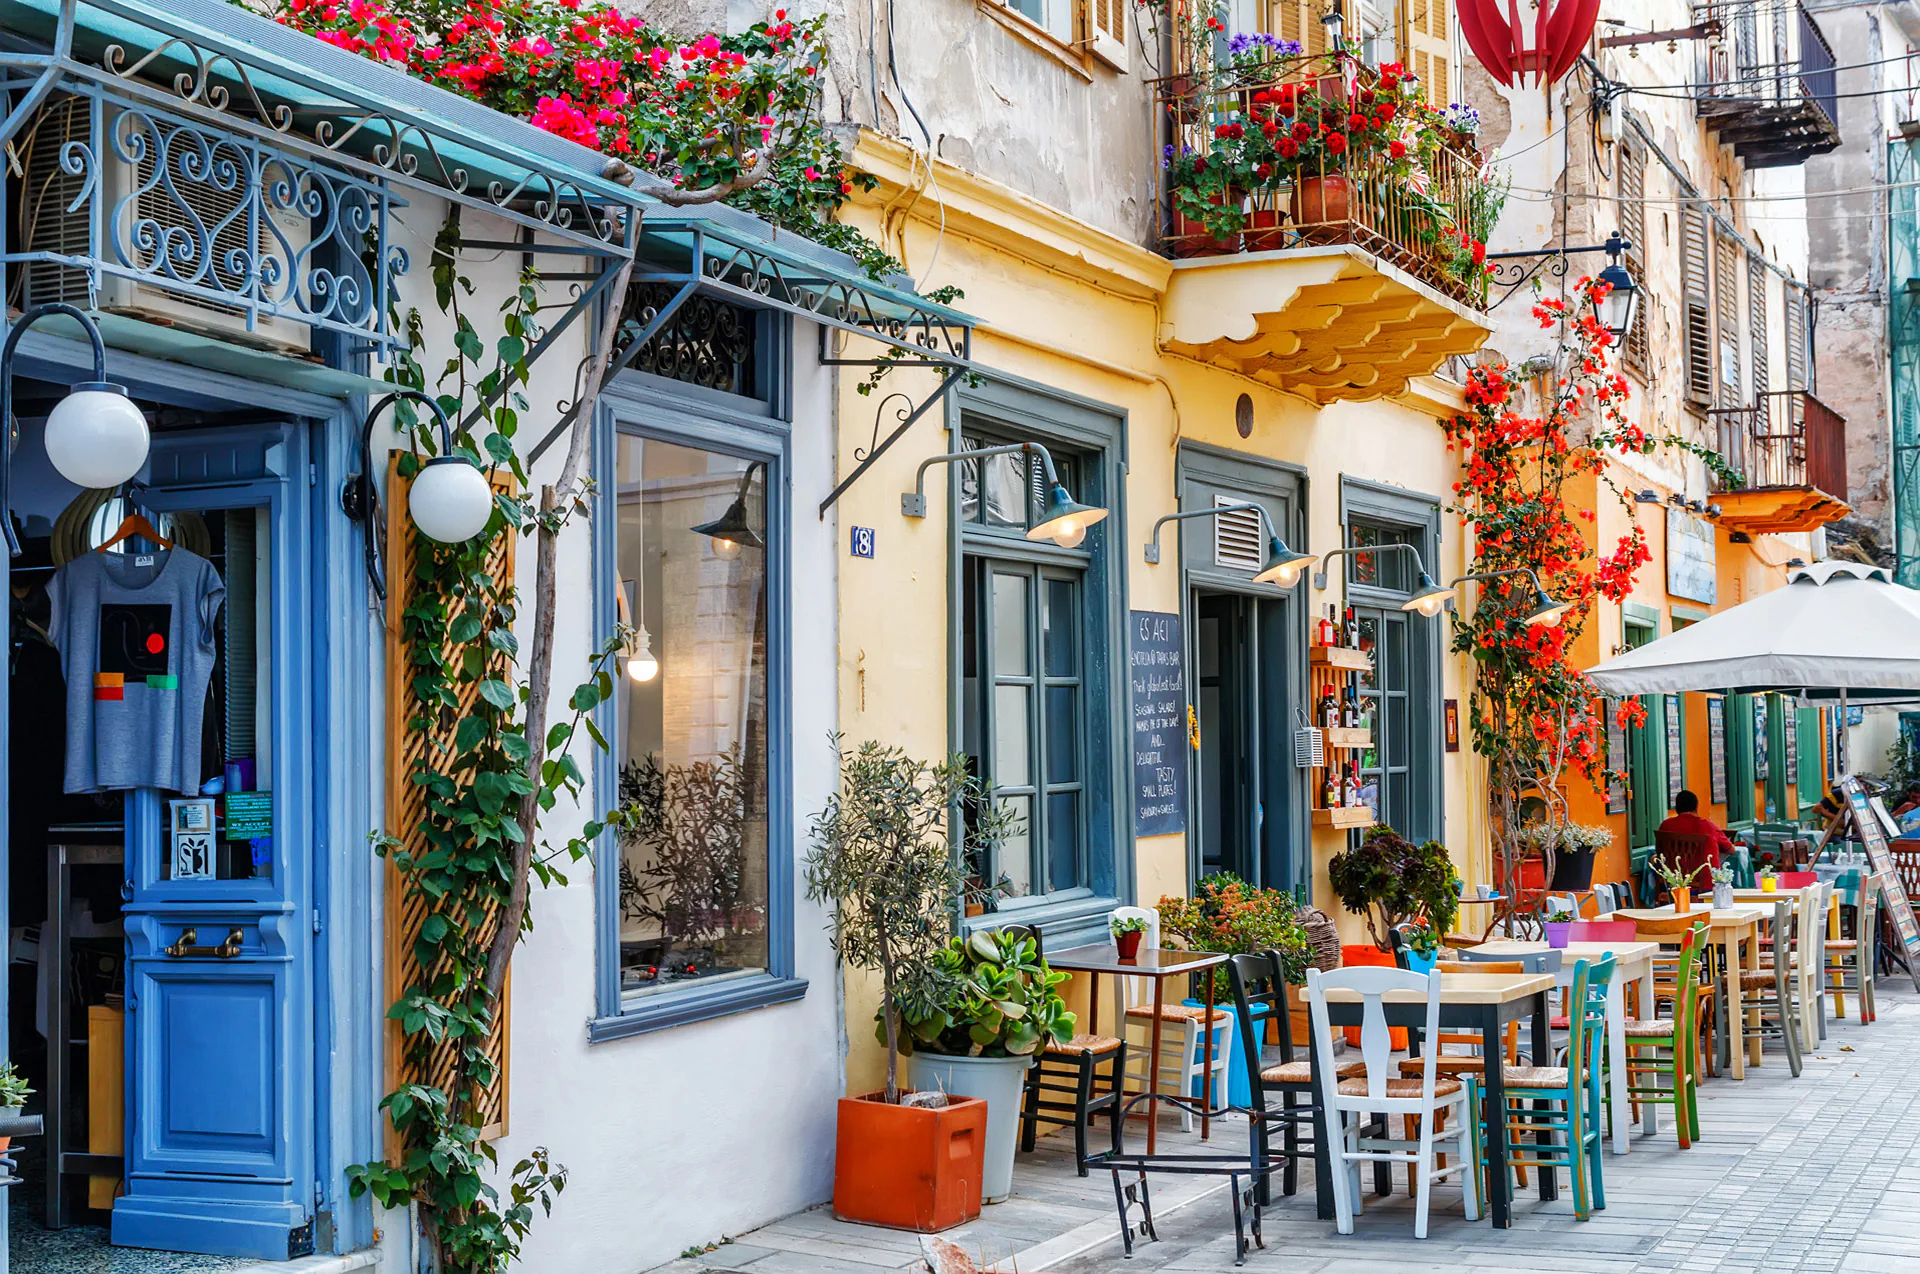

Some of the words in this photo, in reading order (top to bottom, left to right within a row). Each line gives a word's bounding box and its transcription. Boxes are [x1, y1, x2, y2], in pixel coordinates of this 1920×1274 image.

[859, 530, 869, 555] 8
[1140, 617, 1149, 641] ES
[1153, 618, 1168, 642] AEI
[1156, 766, 1175, 782] TASTY
